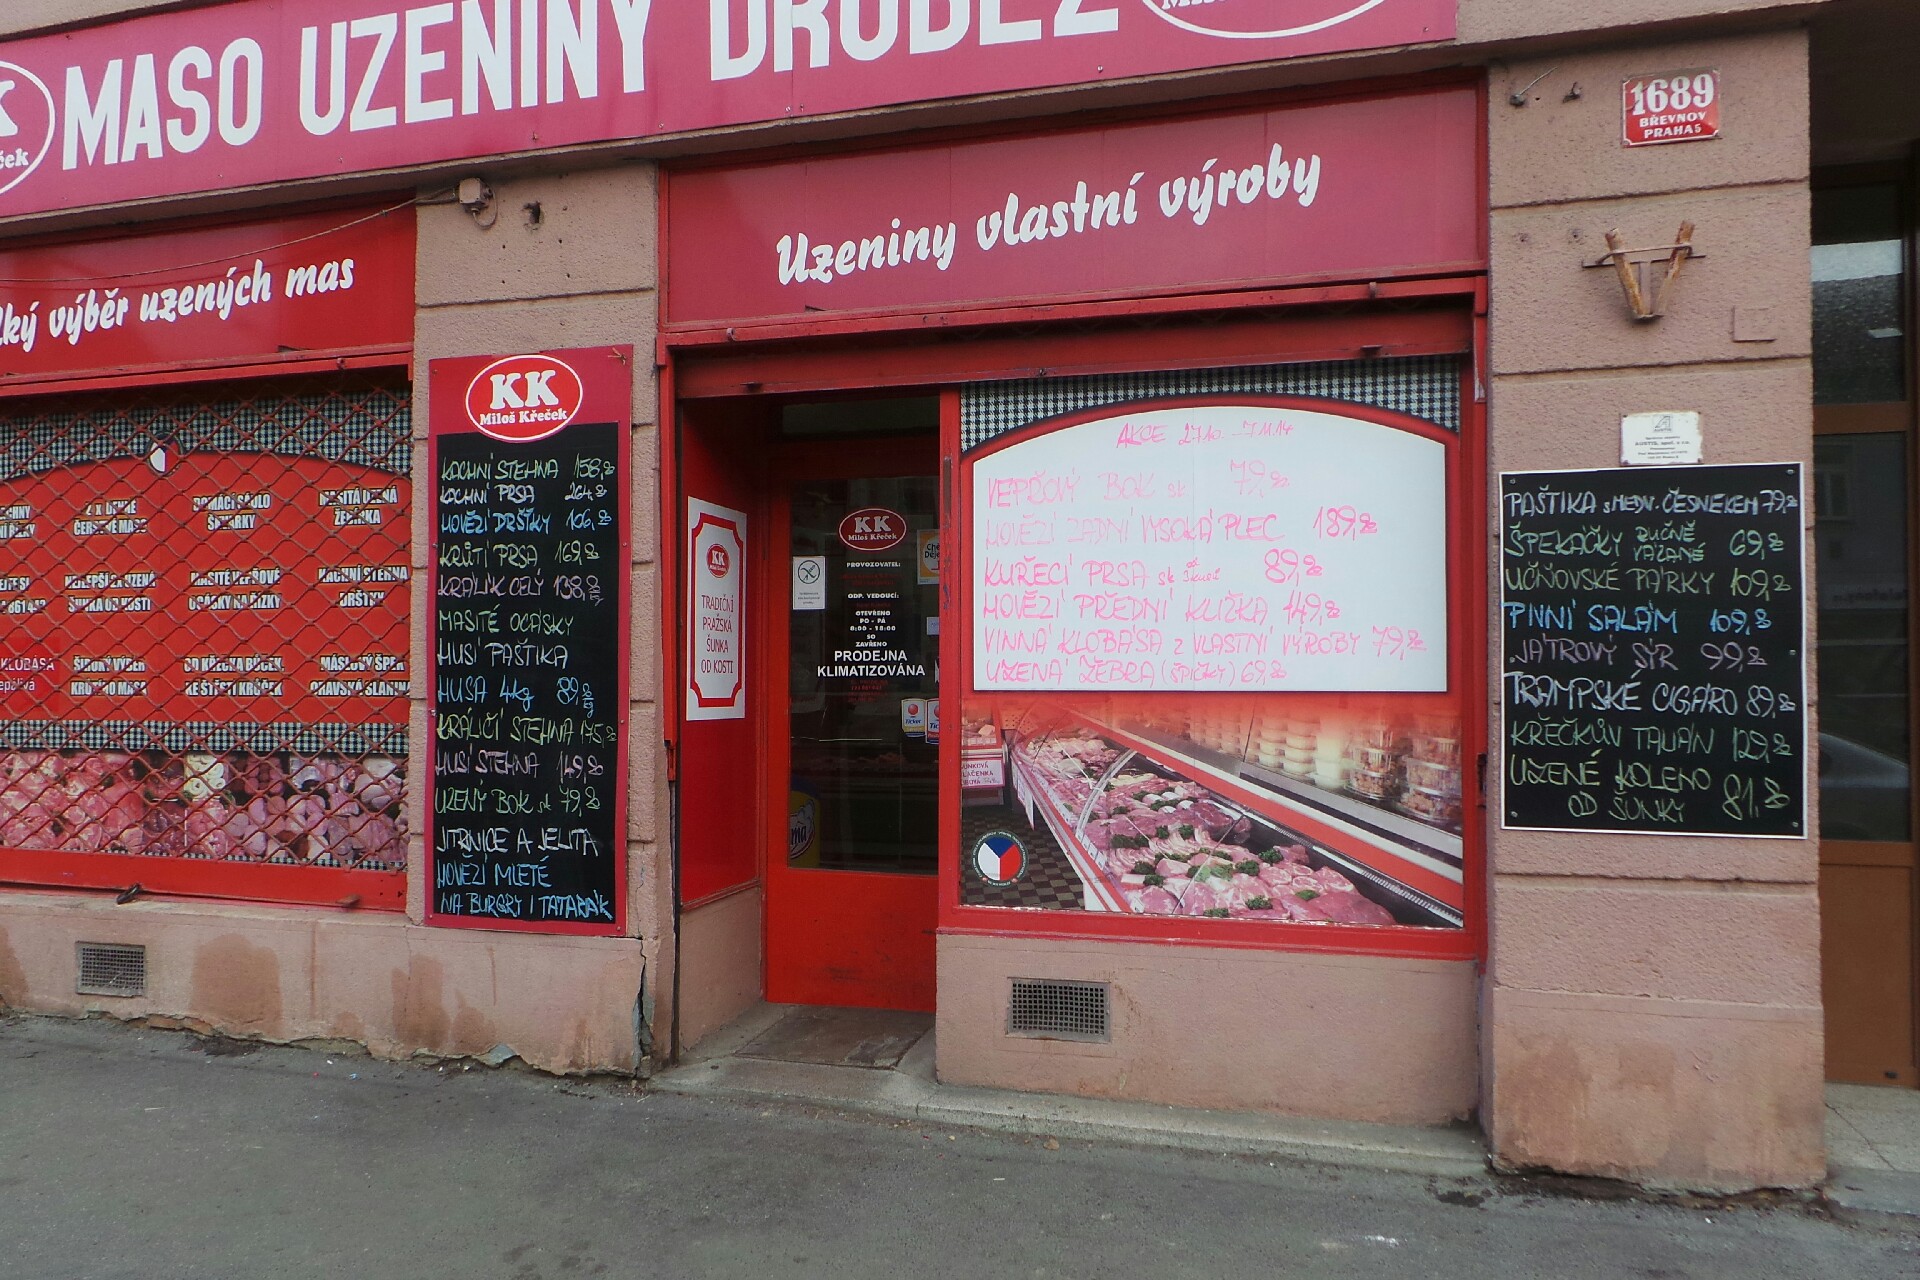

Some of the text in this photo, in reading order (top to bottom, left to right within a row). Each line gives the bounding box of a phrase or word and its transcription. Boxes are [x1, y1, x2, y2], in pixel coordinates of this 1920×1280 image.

[62, 37, 263, 170] MASO
[300, 0, 652, 136] UZENINY
[1631, 74, 1714, 115] 1689
[1639, 111, 1707, 127] BŘEVNOV
[1644, 123, 1702, 139] PRAHA 5
[775, 143, 1321, 285] Uzeniny vlastní výroby
[49, 257, 354, 346] výběr uzených mas
[489, 369, 559, 410] KK
[479, 408, 568, 426] Miloš Křeček
[1116, 422, 1168, 448] AKCE
[494, 484, 535, 503] PRSA
[1098, 472, 1156, 500] BOK
[1504, 485, 1597, 517] PAŠTIKA
[848, 532, 897, 542] Miloš Křeček
[854, 515, 891, 533] KK
[493, 543, 538, 569] PRSA
[711, 550, 725, 566] KK
[1082, 560, 1150, 589] PRSA
[701, 594, 734, 613] TRADIČNÍ
[438, 604, 501, 632] MASITÉ
[702, 613, 732, 633] PRAŽSKÁ
[706, 633, 729, 654] ŠUNKA
[834, 650, 908, 662] PRODEJNA
[701, 659, 734, 674] OD KOSTI
[817, 663, 926, 677] KLIMATIZOVÁNA
[437, 674, 488, 703] HUSA
[1504, 669, 1642, 711] TRAMPSKÉ
[510, 716, 574, 745] STEHNA
[1615, 759, 1711, 793] KOLENO
[491, 788, 534, 815] BOK
[1568, 790, 1597, 818] OD
[517, 828, 533, 854] A
[440, 892, 463, 916] NA
